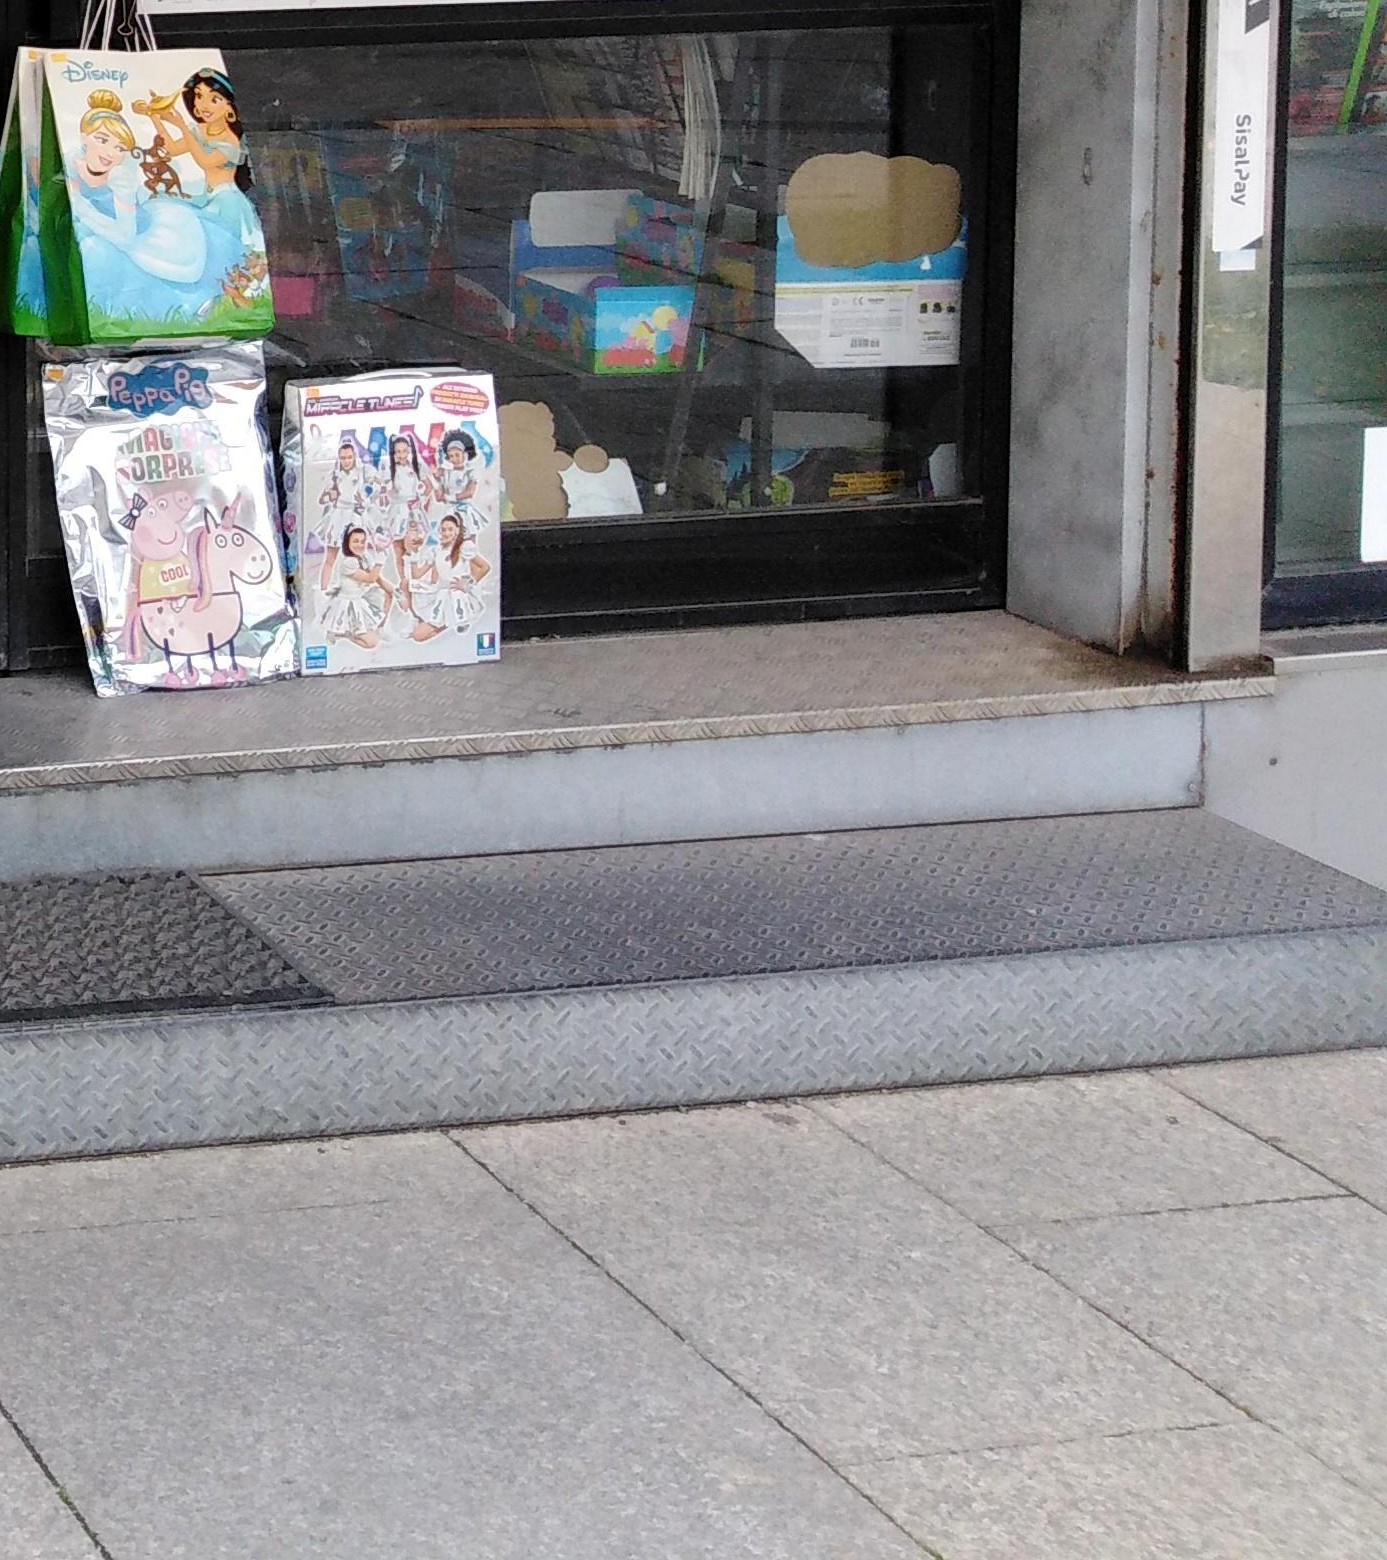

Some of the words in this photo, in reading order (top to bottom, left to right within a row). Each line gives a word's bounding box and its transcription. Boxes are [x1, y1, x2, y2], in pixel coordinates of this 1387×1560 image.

[61, 58, 129, 89] Disney
[1230, 112, 1254, 208] SisalPay
[109, 373, 175, 412] Peppa
[173, 367, 211, 409] Pig
[160, 565, 190, 584] COOL
